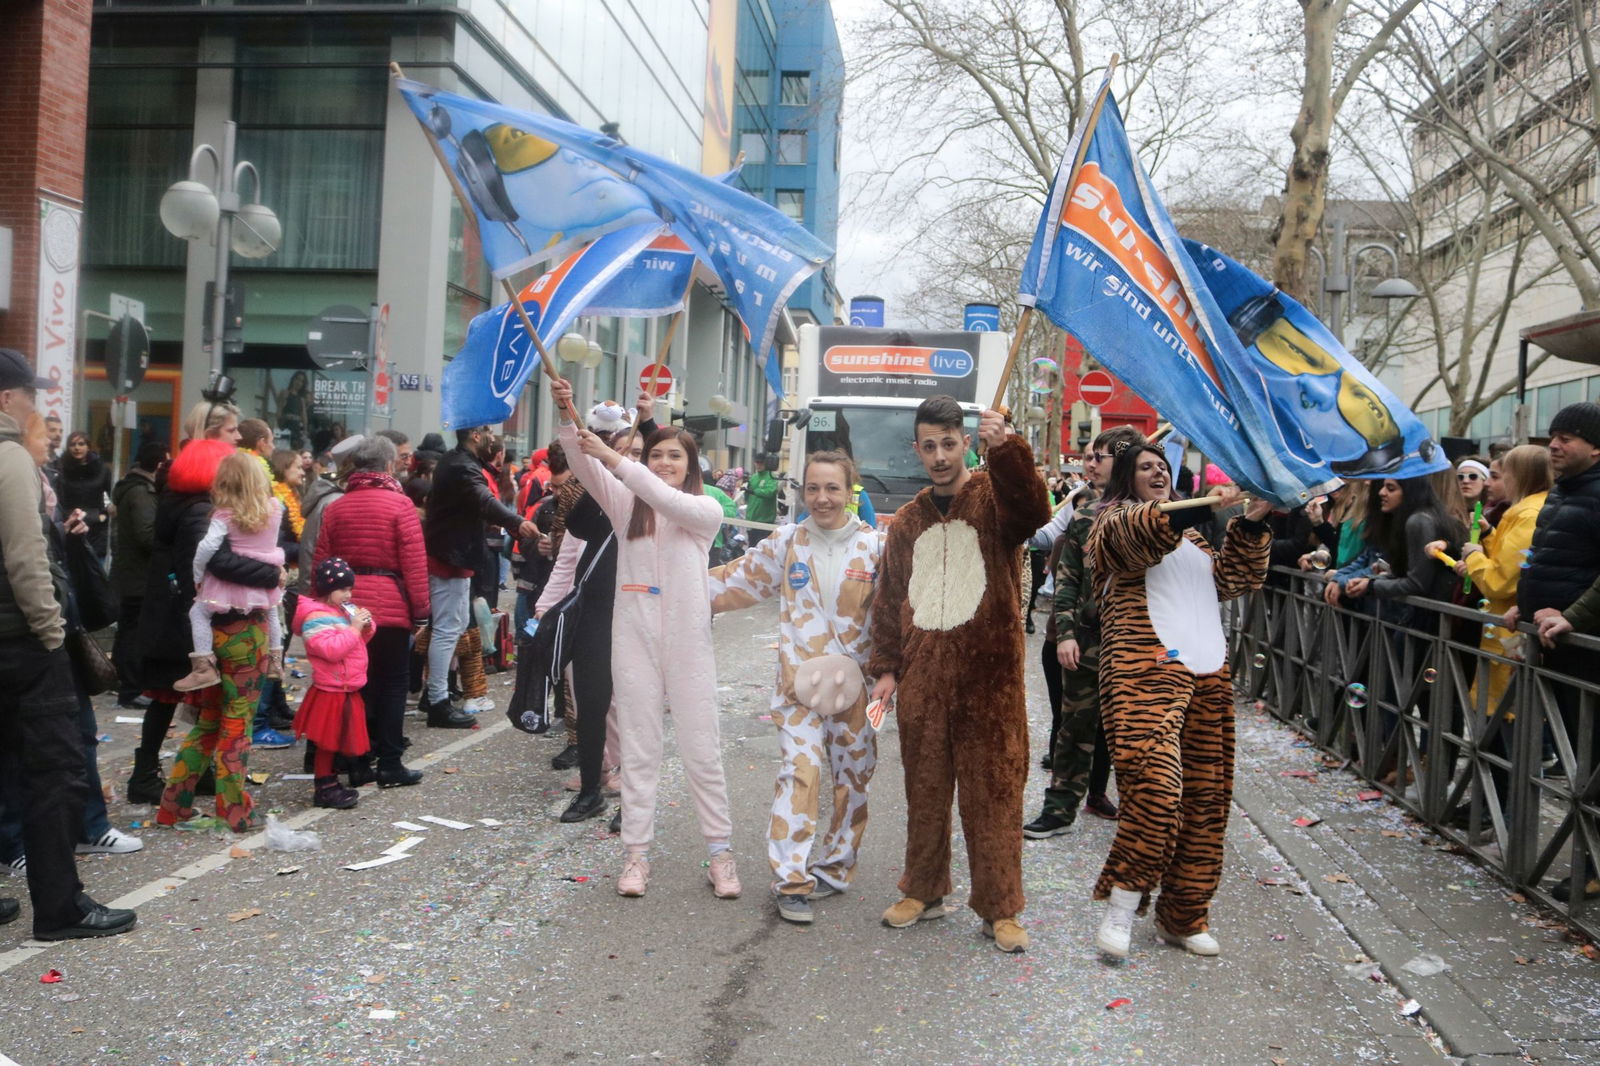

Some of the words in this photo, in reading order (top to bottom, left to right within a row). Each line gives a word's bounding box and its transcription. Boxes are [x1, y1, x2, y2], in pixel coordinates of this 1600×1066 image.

[1065, 242, 1104, 272] wir
[1103, 275, 1151, 320] sind
[1153, 321, 1197, 370] unte
[44, 281, 65, 350] Vivo
[831, 352, 925, 366] sunshine
[933, 354, 967, 369] live
[314, 379, 348, 392] BREAK
[352, 381, 366, 393] TH
[401, 375, 418, 385] N5
[840, 376, 883, 384] electronic
[886, 377, 912, 385] music
[914, 378, 937, 386] radio
[813, 416, 831, 427] 96.
